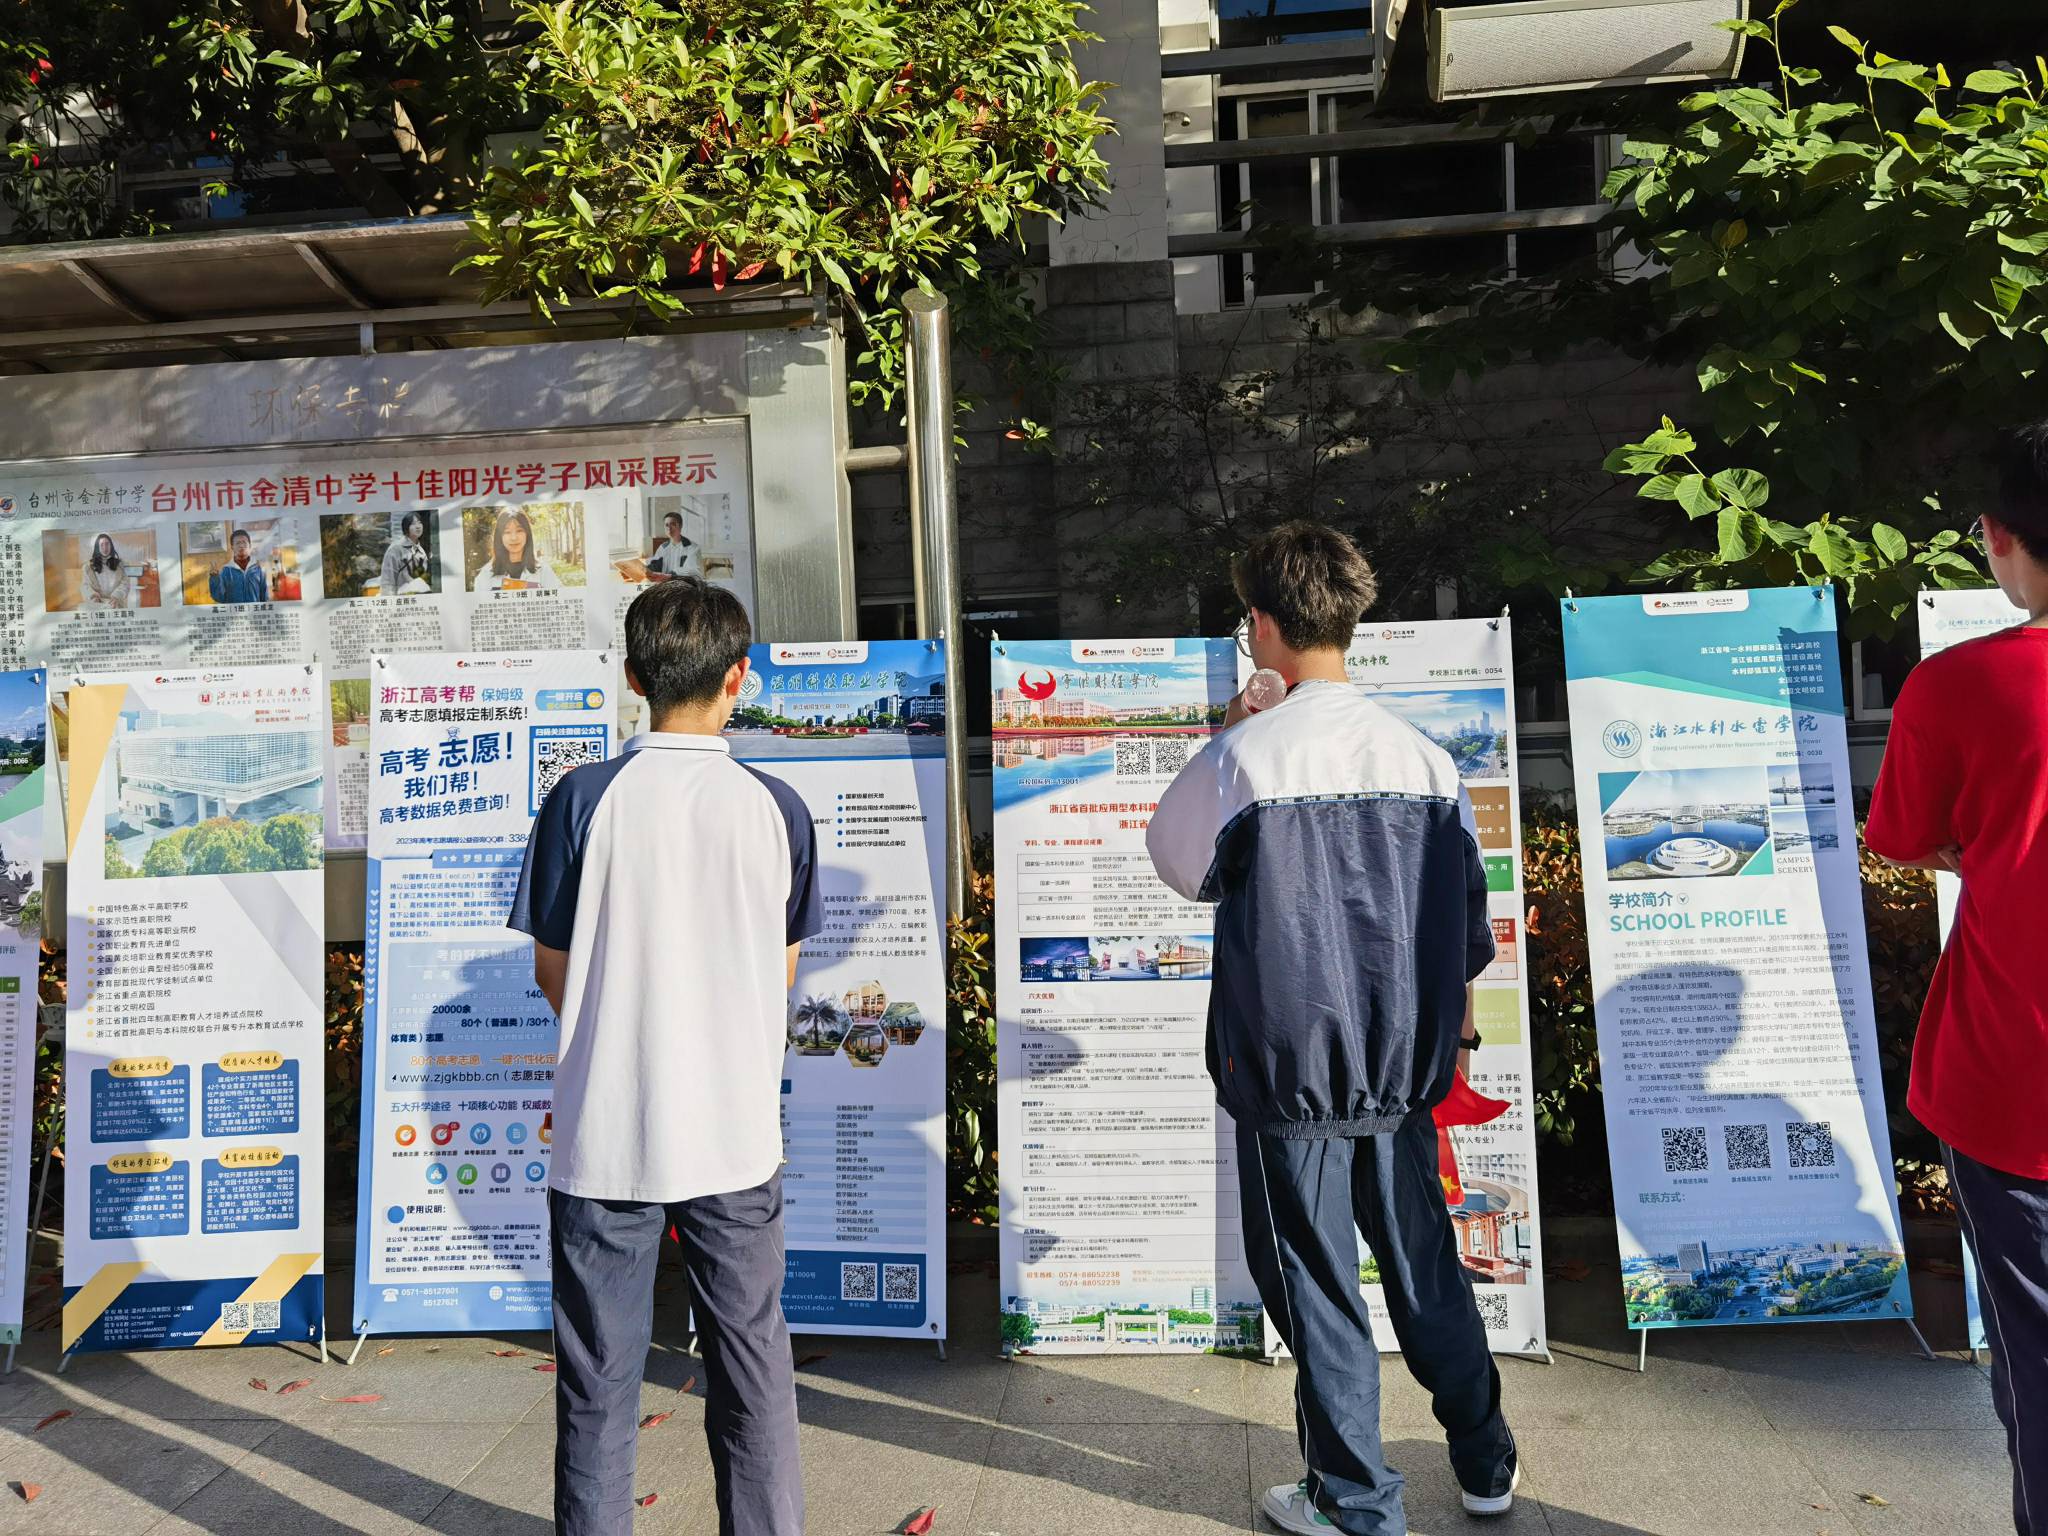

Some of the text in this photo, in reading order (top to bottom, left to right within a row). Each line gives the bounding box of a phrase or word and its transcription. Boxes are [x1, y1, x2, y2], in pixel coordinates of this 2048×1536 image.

[151, 453, 718, 514] 台州市金清中学十佳阳光学子风采展示
[28, 485, 145, 509] 台州市金清中学
[112, 506, 143, 514] SCHOOL
[1700, 641, 1821, 655] 浙江省唯一水利部和浙江省共建高校
[1731, 652, 1822, 664] 浙江省应用型示范建设高校
[1778, 675, 1824, 685] 全国文明单位
[380, 685, 476, 704] 浙江高考帮
[481, 687, 524, 702] 保姆级
[1778, 686, 1825, 696] 全国文明校园
[379, 706, 528, 723] 高考志愿填报定制系统！
[536, 727, 604, 737] 扫码关注微信公众号
[379, 747, 431, 777] 高考
[403, 771, 479, 799] 我们帮！
[379, 794, 510, 825] 高考数据免费查询！
[1050, 802, 1158, 814] 浙江省首批应用型本科建
[1119, 819, 1148, 829] 浙江省
[1777, 856, 1810, 864] CAMPUS
[1777, 865, 1814, 874] SCENERY
[1608, 891, 1673, 909] 学校简介
[1609, 908, 1788, 932] SCHOOL PROFILE
[432, 1004, 471, 1015] 20000余
[391, 1101, 451, 1112] 五大升学途径
[457, 1100, 517, 1111] 十项核心功能
[1514, 1098, 1522, 1106] 国
[1639, 1191, 1686, 1204] 联系方式：
[406, 1204, 446, 1215] 使用说明：
